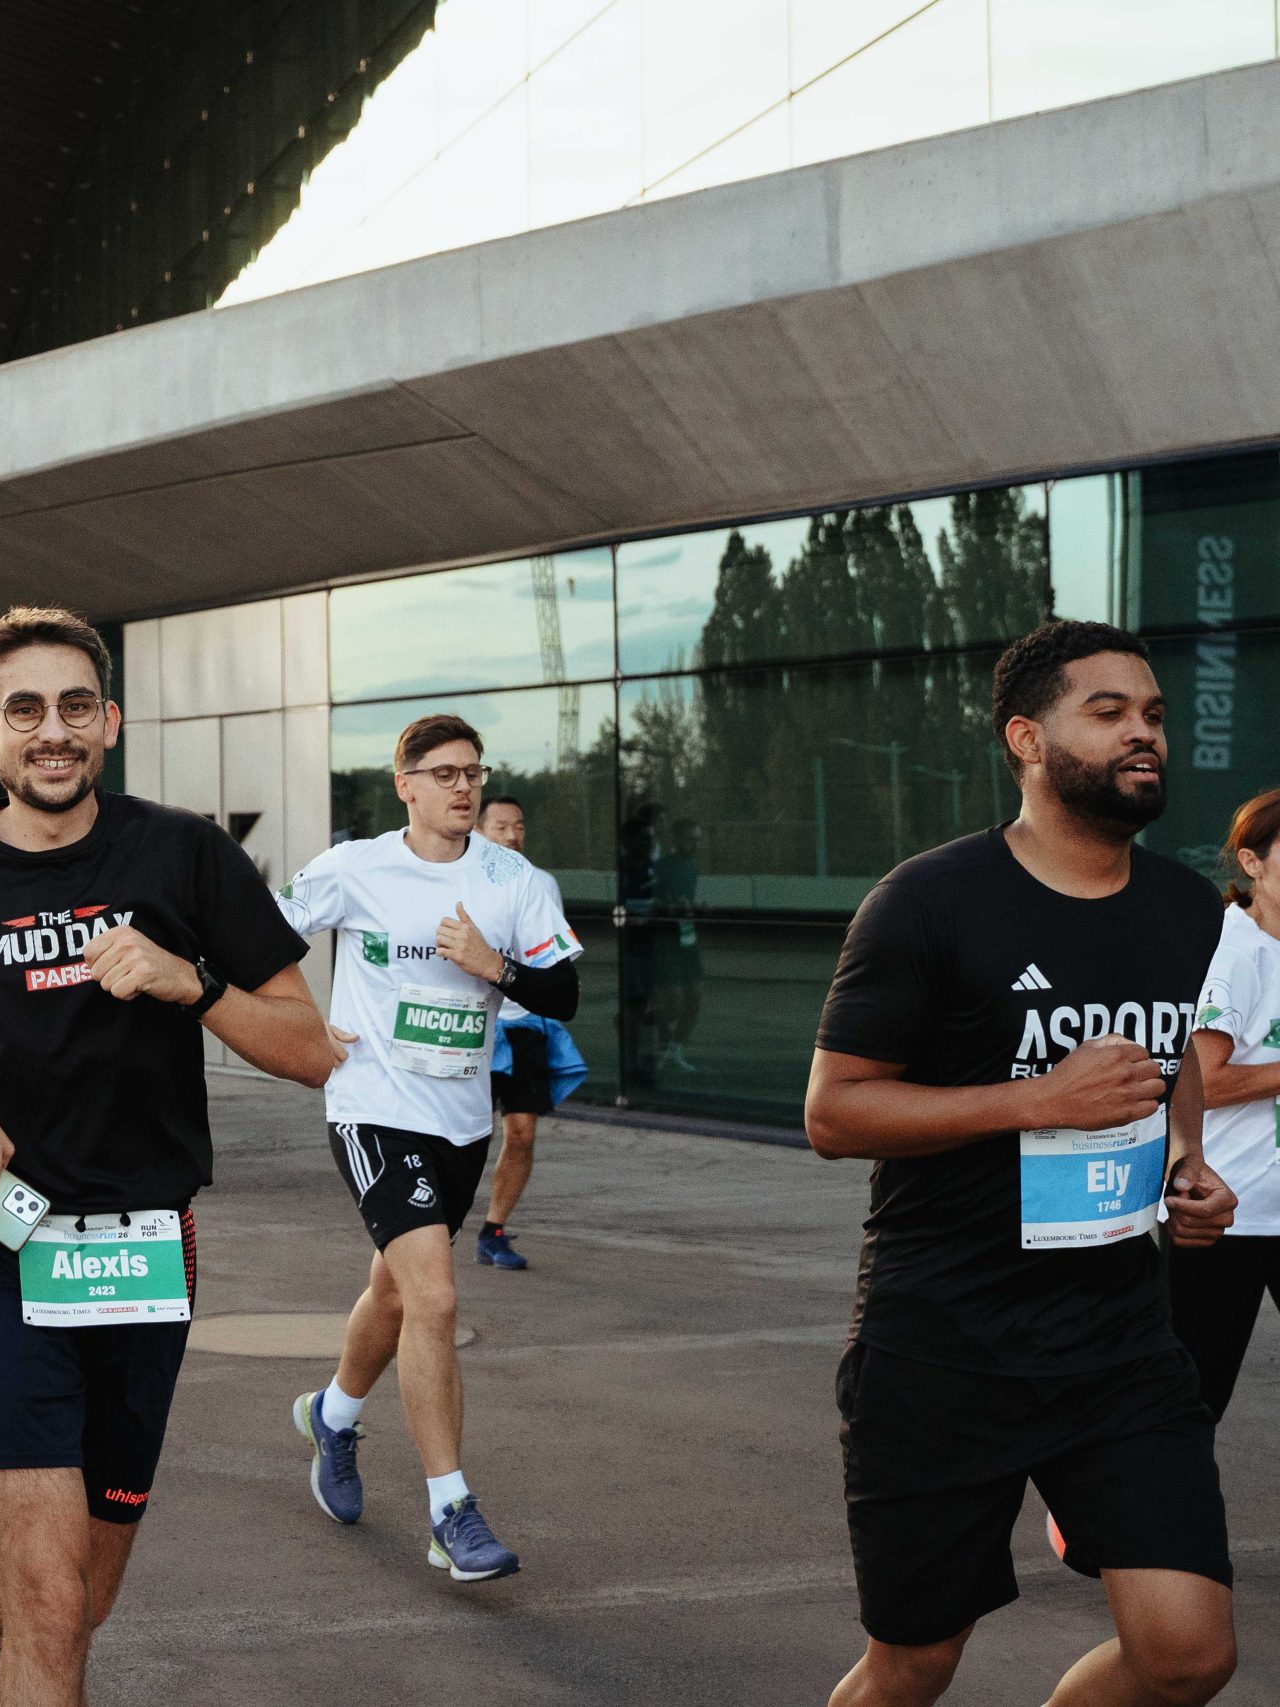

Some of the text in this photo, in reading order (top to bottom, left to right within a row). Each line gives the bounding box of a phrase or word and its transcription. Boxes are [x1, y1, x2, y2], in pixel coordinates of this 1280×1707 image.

[39, 910, 72, 926] THE
[397, 945, 437, 960] BNP
[30, 964, 92, 989] PARIS
[405, 1007, 485, 1034] NICOLAS
[438, 1035, 451, 1043] 672
[463, 1066, 478, 1075] 672
[403, 1154, 423, 1169] 18
[1087, 1160, 1131, 1196] Ely
[51, 1249, 148, 1279] Alexis
[88, 1285, 116, 1296] 2423
[32, 1307, 71, 1315] LUXEMBOURG
